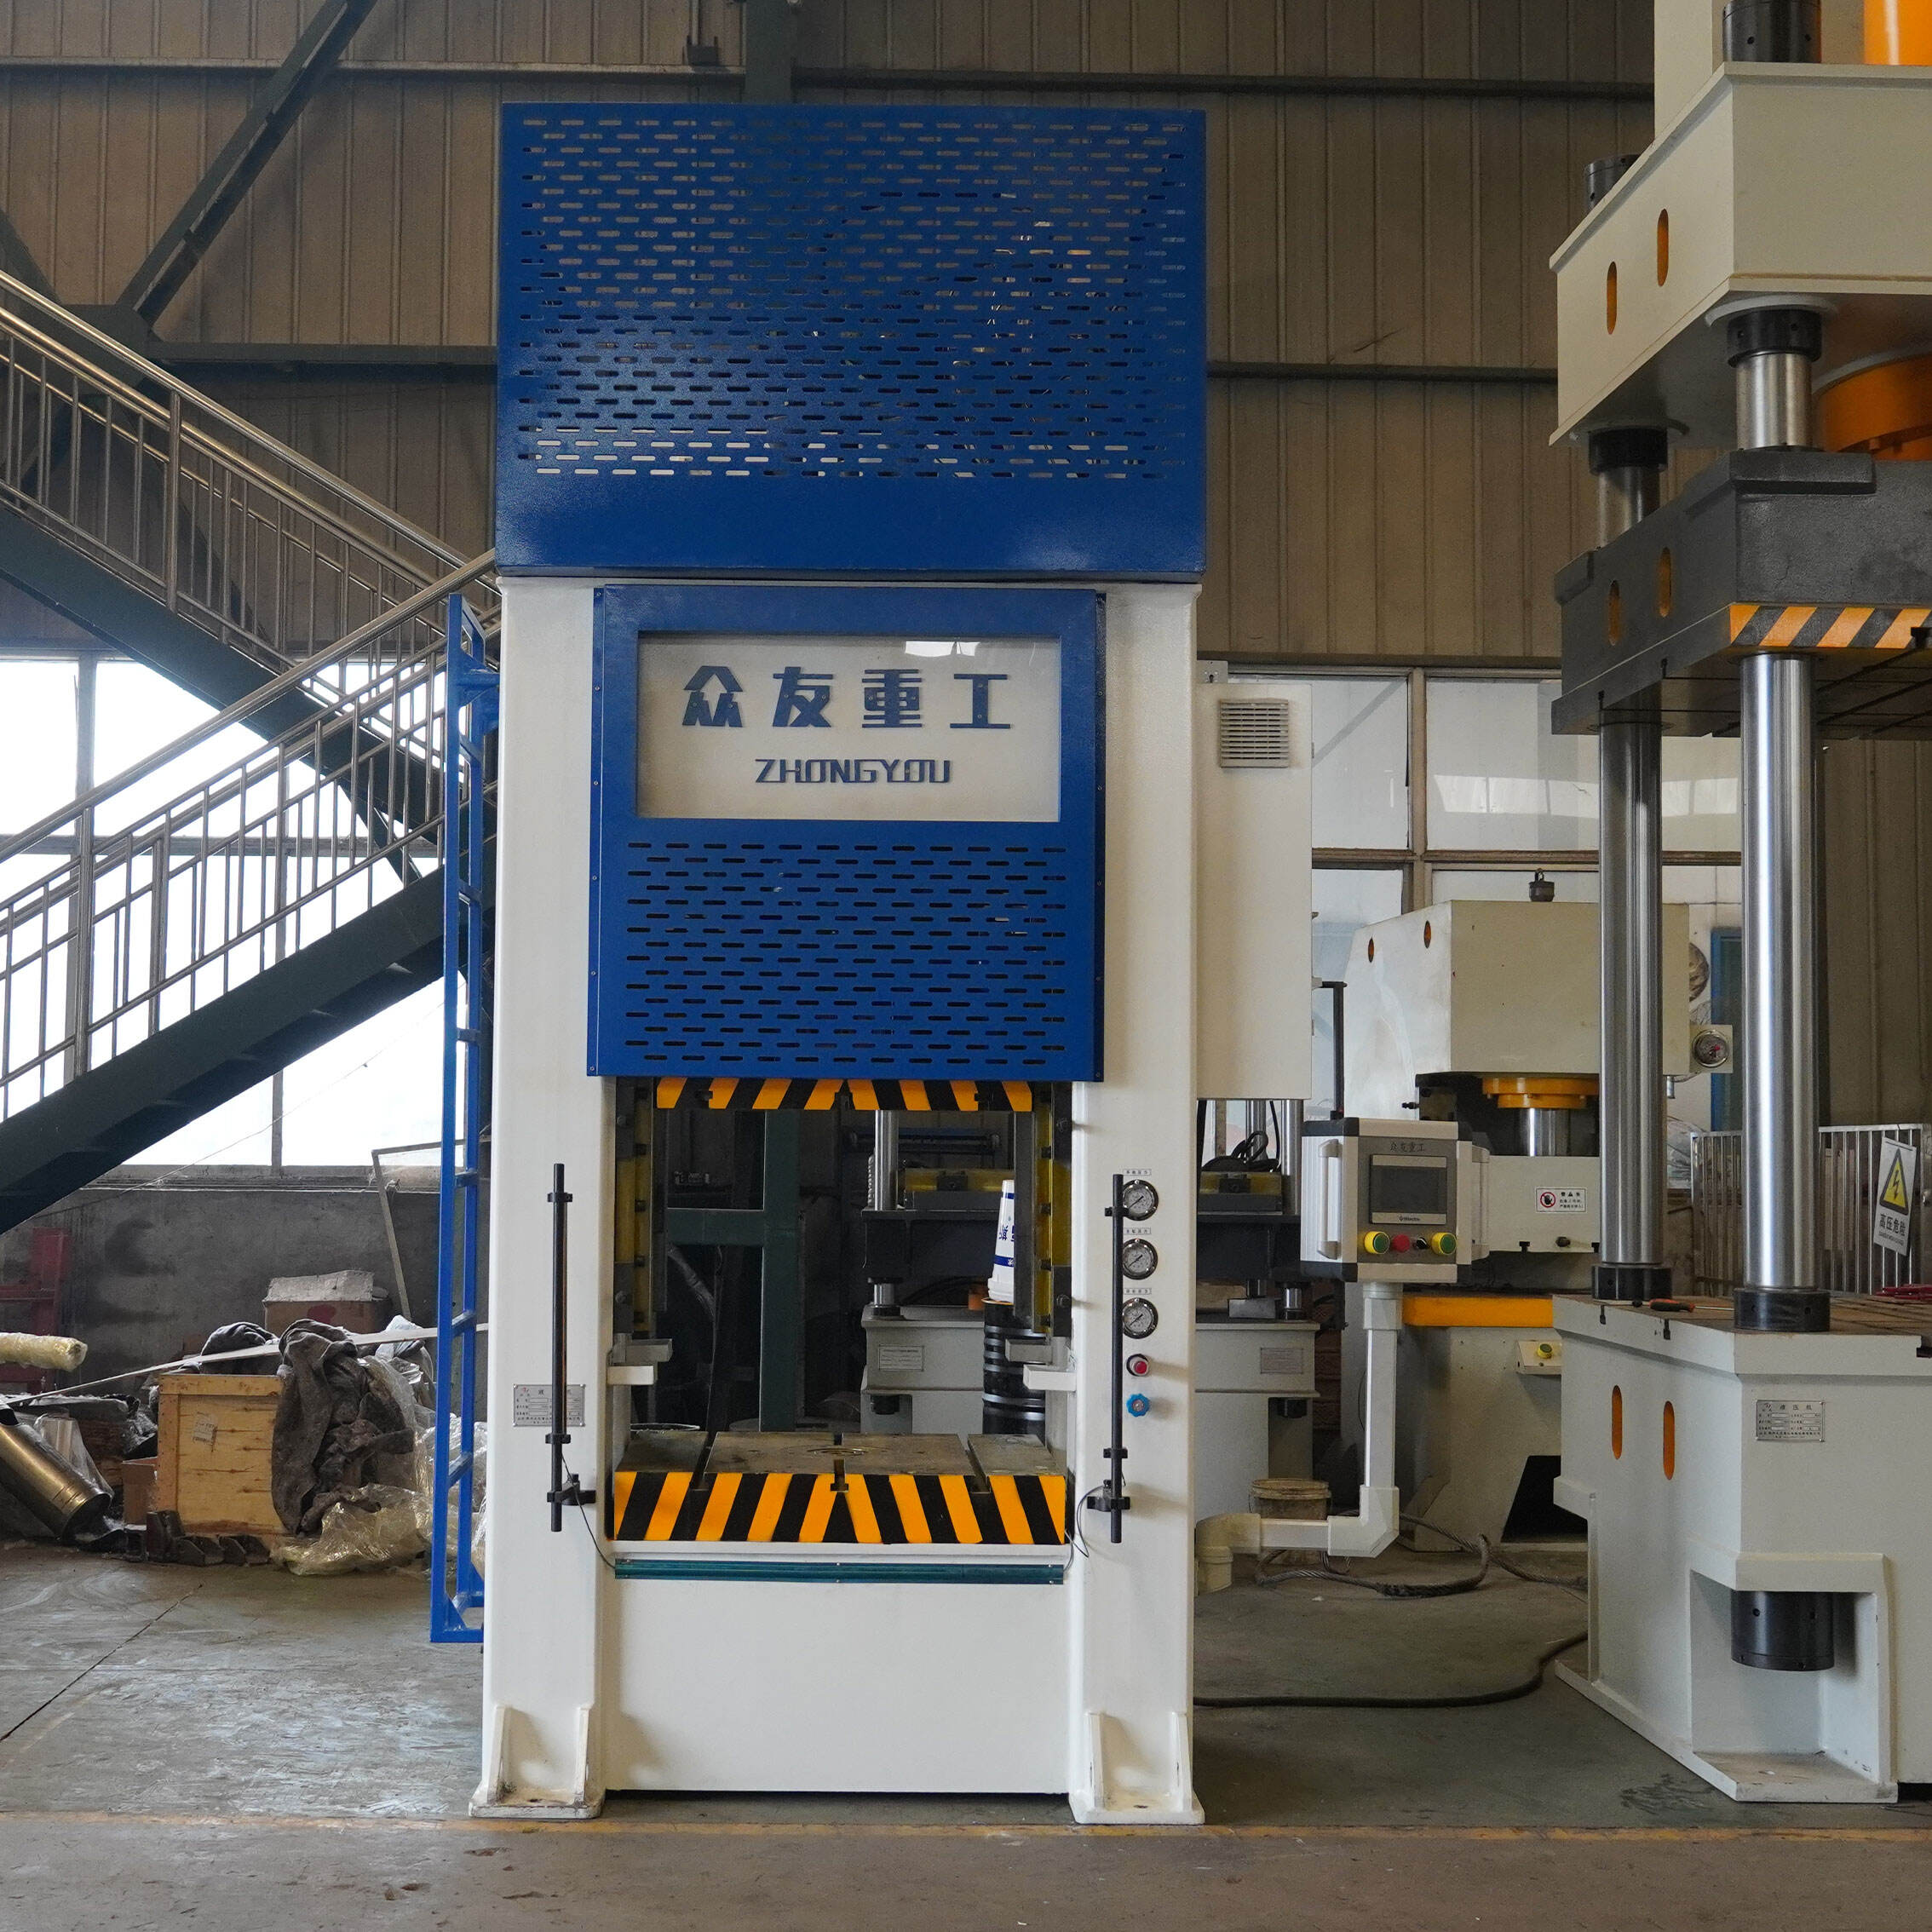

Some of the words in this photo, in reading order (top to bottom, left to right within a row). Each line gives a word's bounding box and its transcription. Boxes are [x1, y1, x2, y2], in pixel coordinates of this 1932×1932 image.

[682, 665, 1011, 729] 众友重工
[755, 759, 951, 784] ZHONGYOU
[1878, 1213, 1906, 1237] 高压危险
